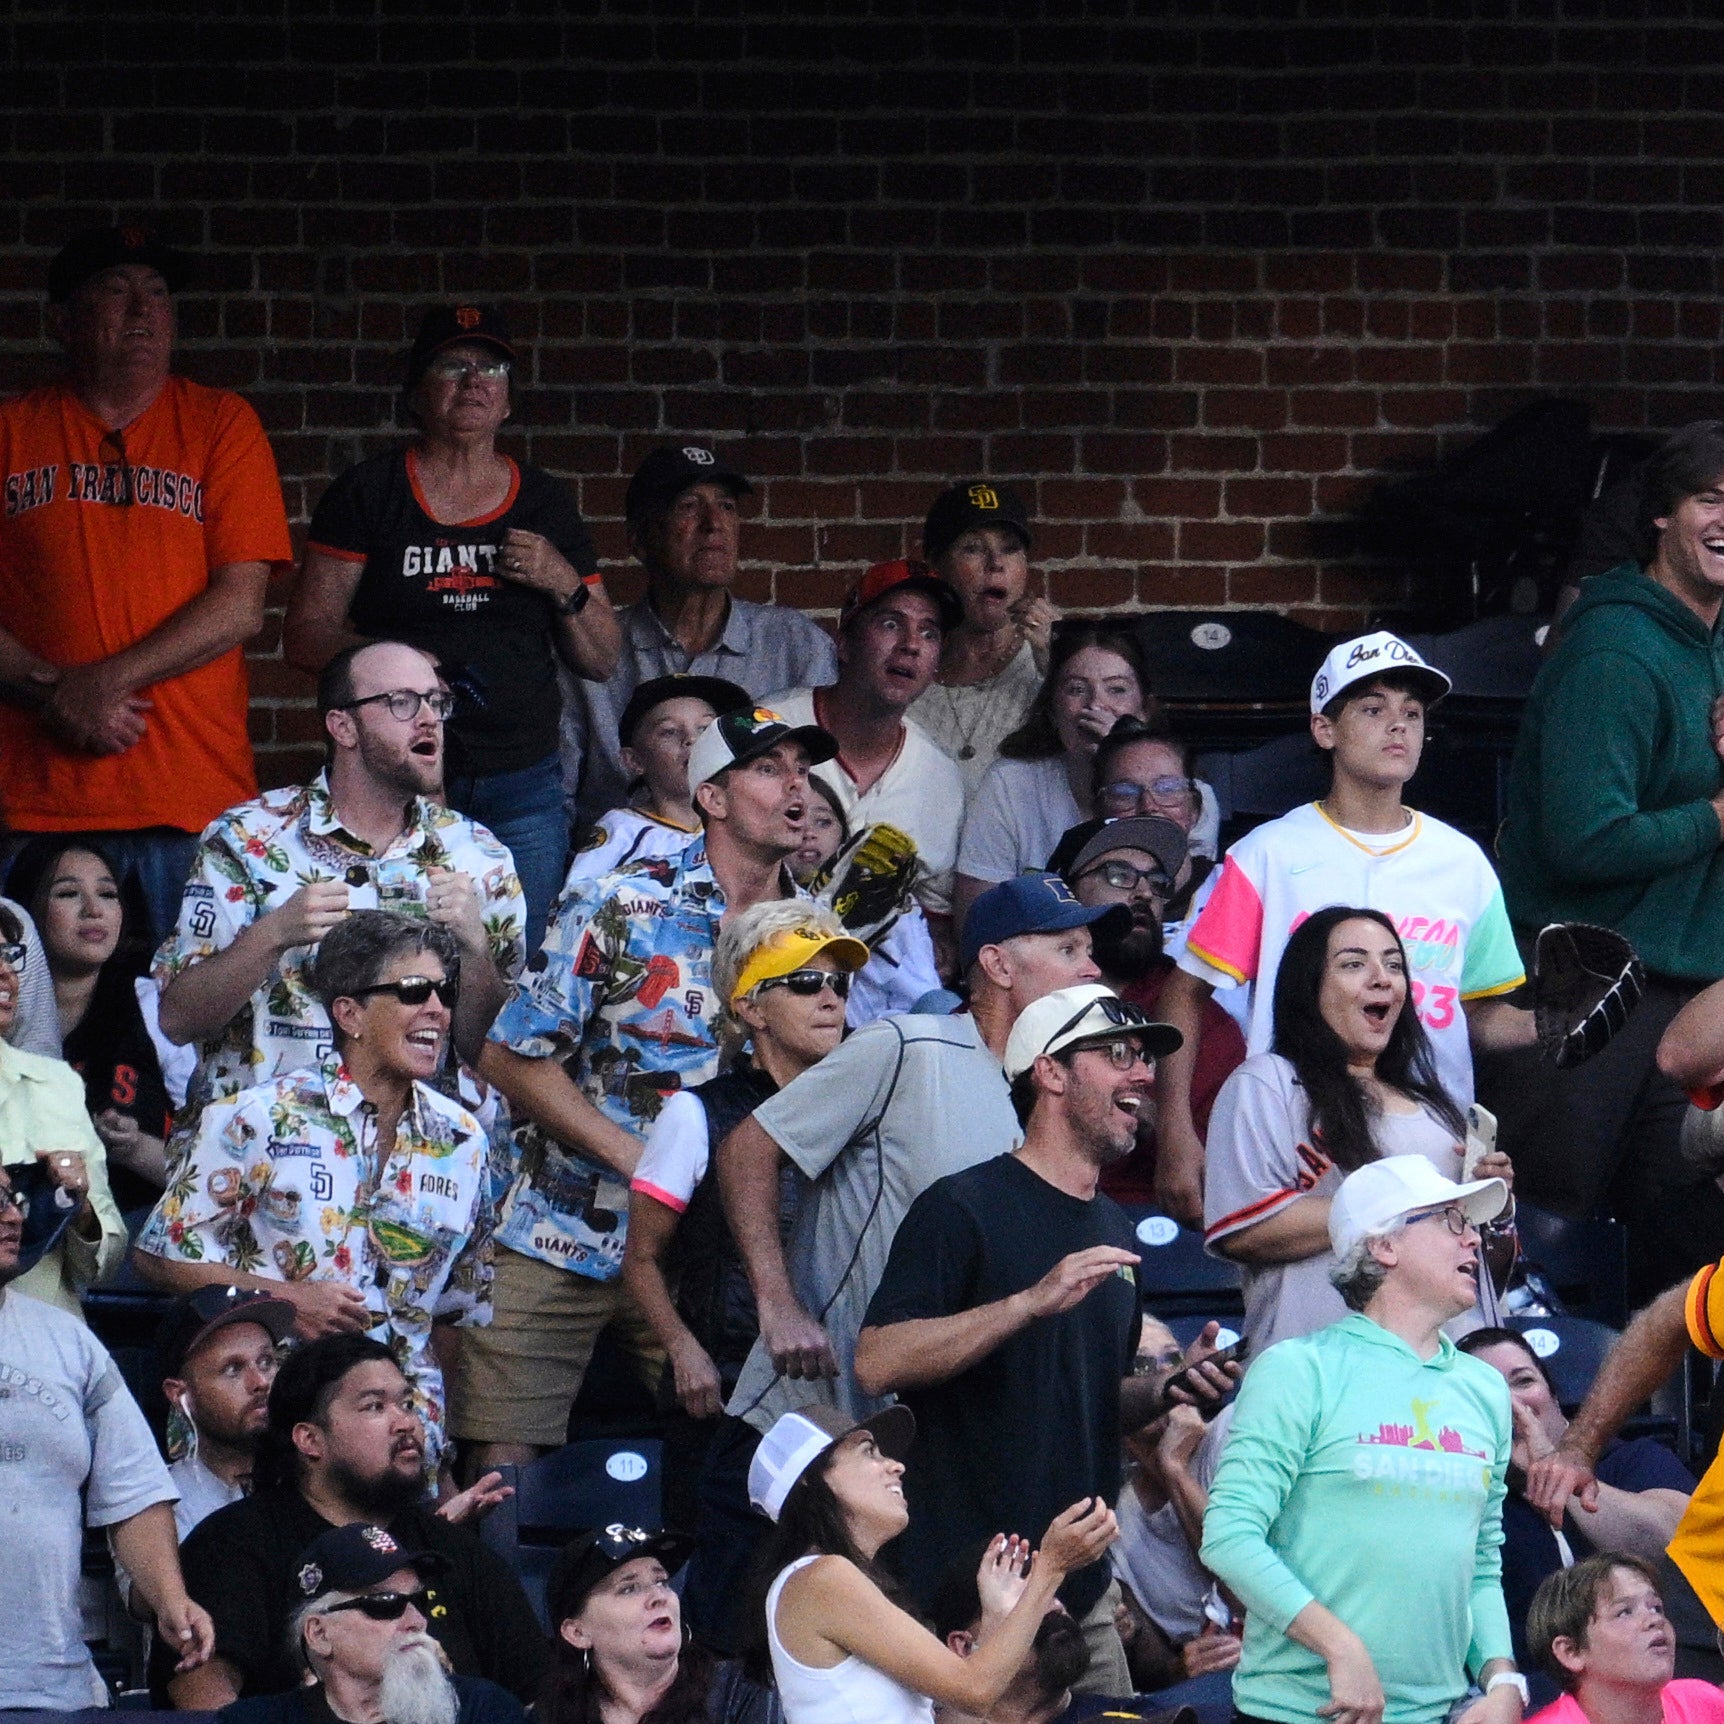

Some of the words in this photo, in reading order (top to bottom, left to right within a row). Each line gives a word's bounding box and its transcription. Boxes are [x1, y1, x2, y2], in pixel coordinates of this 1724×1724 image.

[5, 465, 59, 520] SAN
[967, 483, 1001, 511] SD
[401, 544, 500, 579] GIANT
[1345, 642, 1382, 671] San
[189, 899, 218, 939] SD
[309, 1161, 333, 1203] SD
[419, 1173, 459, 1203] ADRES
[621, 1458, 633, 1474] 11
